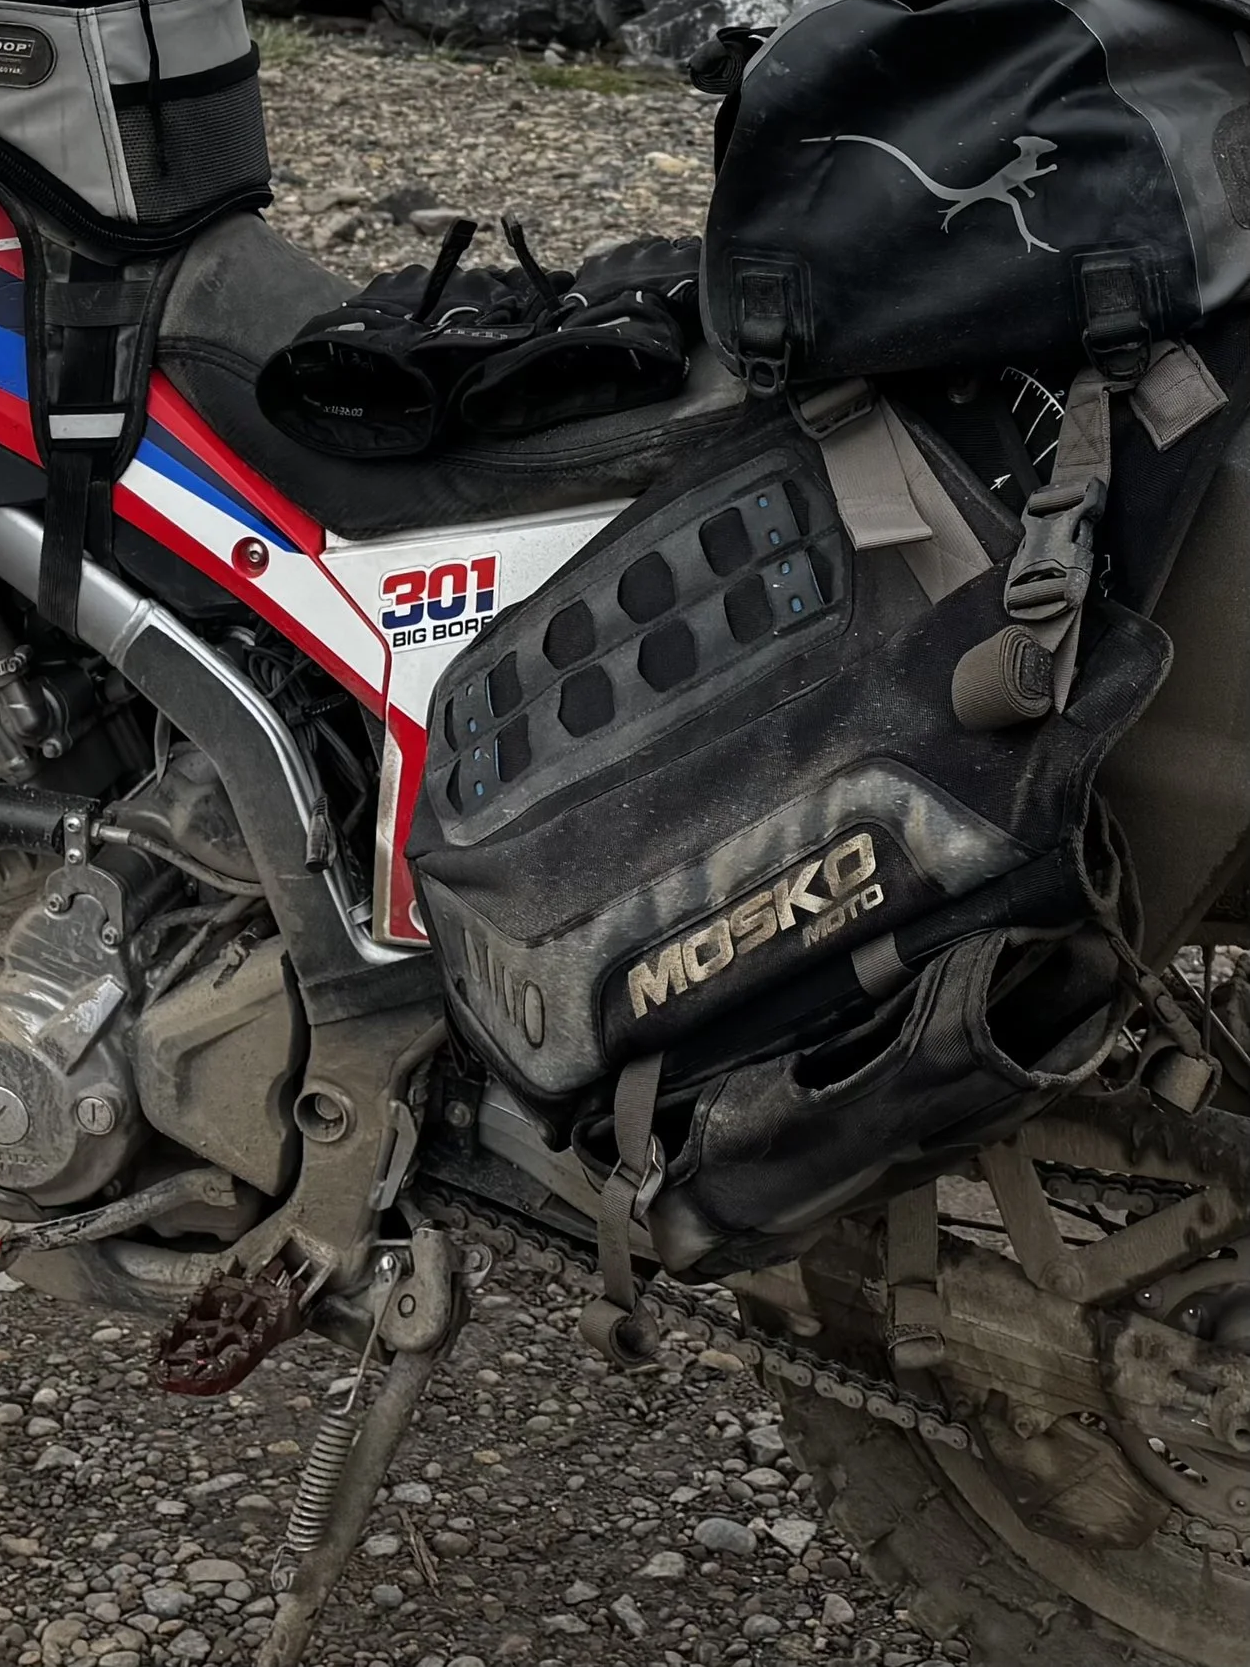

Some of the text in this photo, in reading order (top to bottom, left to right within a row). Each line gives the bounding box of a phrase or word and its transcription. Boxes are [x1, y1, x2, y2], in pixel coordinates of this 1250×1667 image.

[382, 556, 496, 630] 301
[392, 628, 427, 647] BIG
[628, 833, 876, 1019] MOSKO
[802, 884, 884, 948] MOTO
